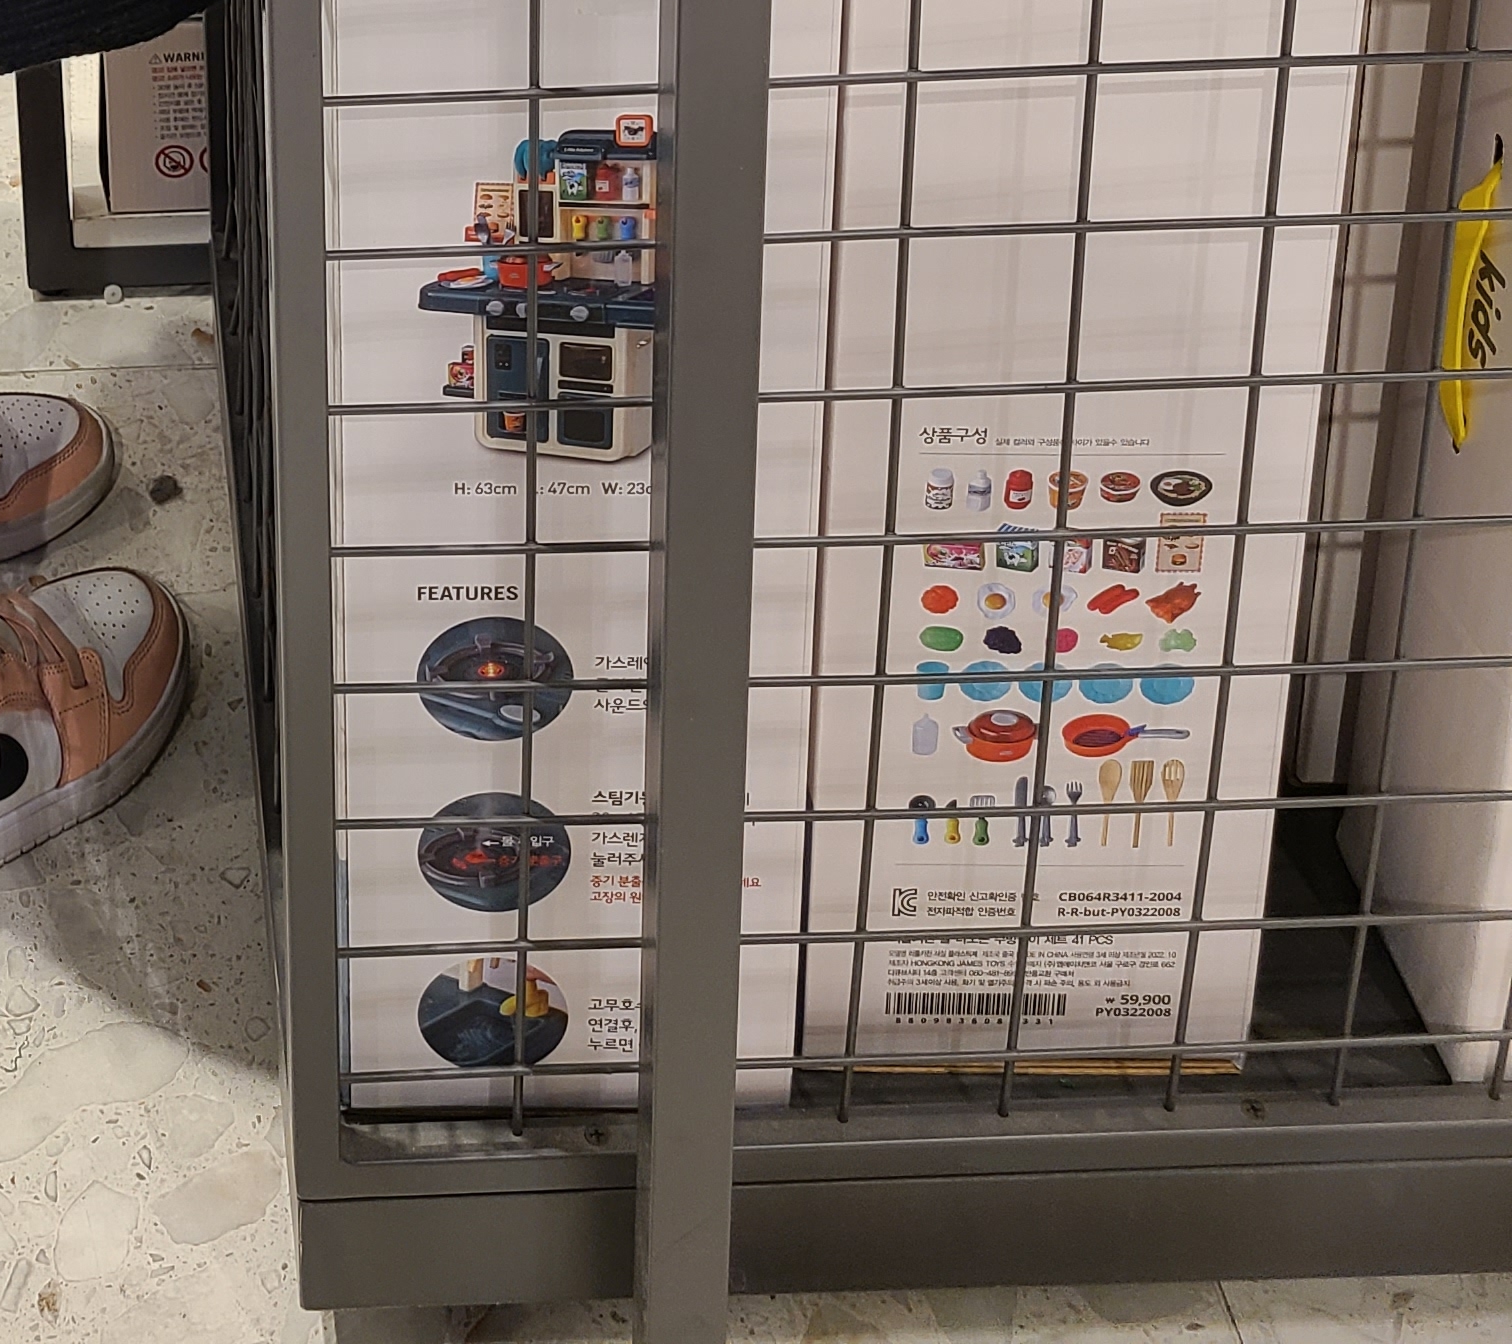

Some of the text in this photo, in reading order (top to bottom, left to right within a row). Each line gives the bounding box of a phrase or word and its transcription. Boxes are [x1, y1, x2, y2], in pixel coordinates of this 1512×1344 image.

[1468, 249, 1506, 369] kids
[919, 426, 988, 445] 상품구성
[995, 438, 1010, 446] 실제
[1038, 438, 1062, 446] 구성품
[1120, 438, 1150, 447] 있습니다
[454, 482, 471, 495] H:
[474, 482, 518, 495] 63cm
[547, 482, 591, 495] 47cm
[601, 482, 623, 495] W:
[416, 585, 519, 601] FEATURES
[590, 875, 615, 887] 증기
[617, 874, 642, 888] 분출
[590, 891, 642, 904] 고장의 원
[927, 891, 1182, 902] 안전확인 신고확인증 CB064R3411-2004
[926, 906, 1181, 917] 전자파적합 인증번호 R-R-but-PY0322008
[1071, 934, 1084, 945] 41
[1088, 934, 1114, 945] PCS
[1119, 994, 1172, 1007] 59,900
[1095, 1007, 1172, 1017] PY0322008
[588, 1018, 637, 1034] 연결후,
[587, 1037, 633, 1053] 누르면
